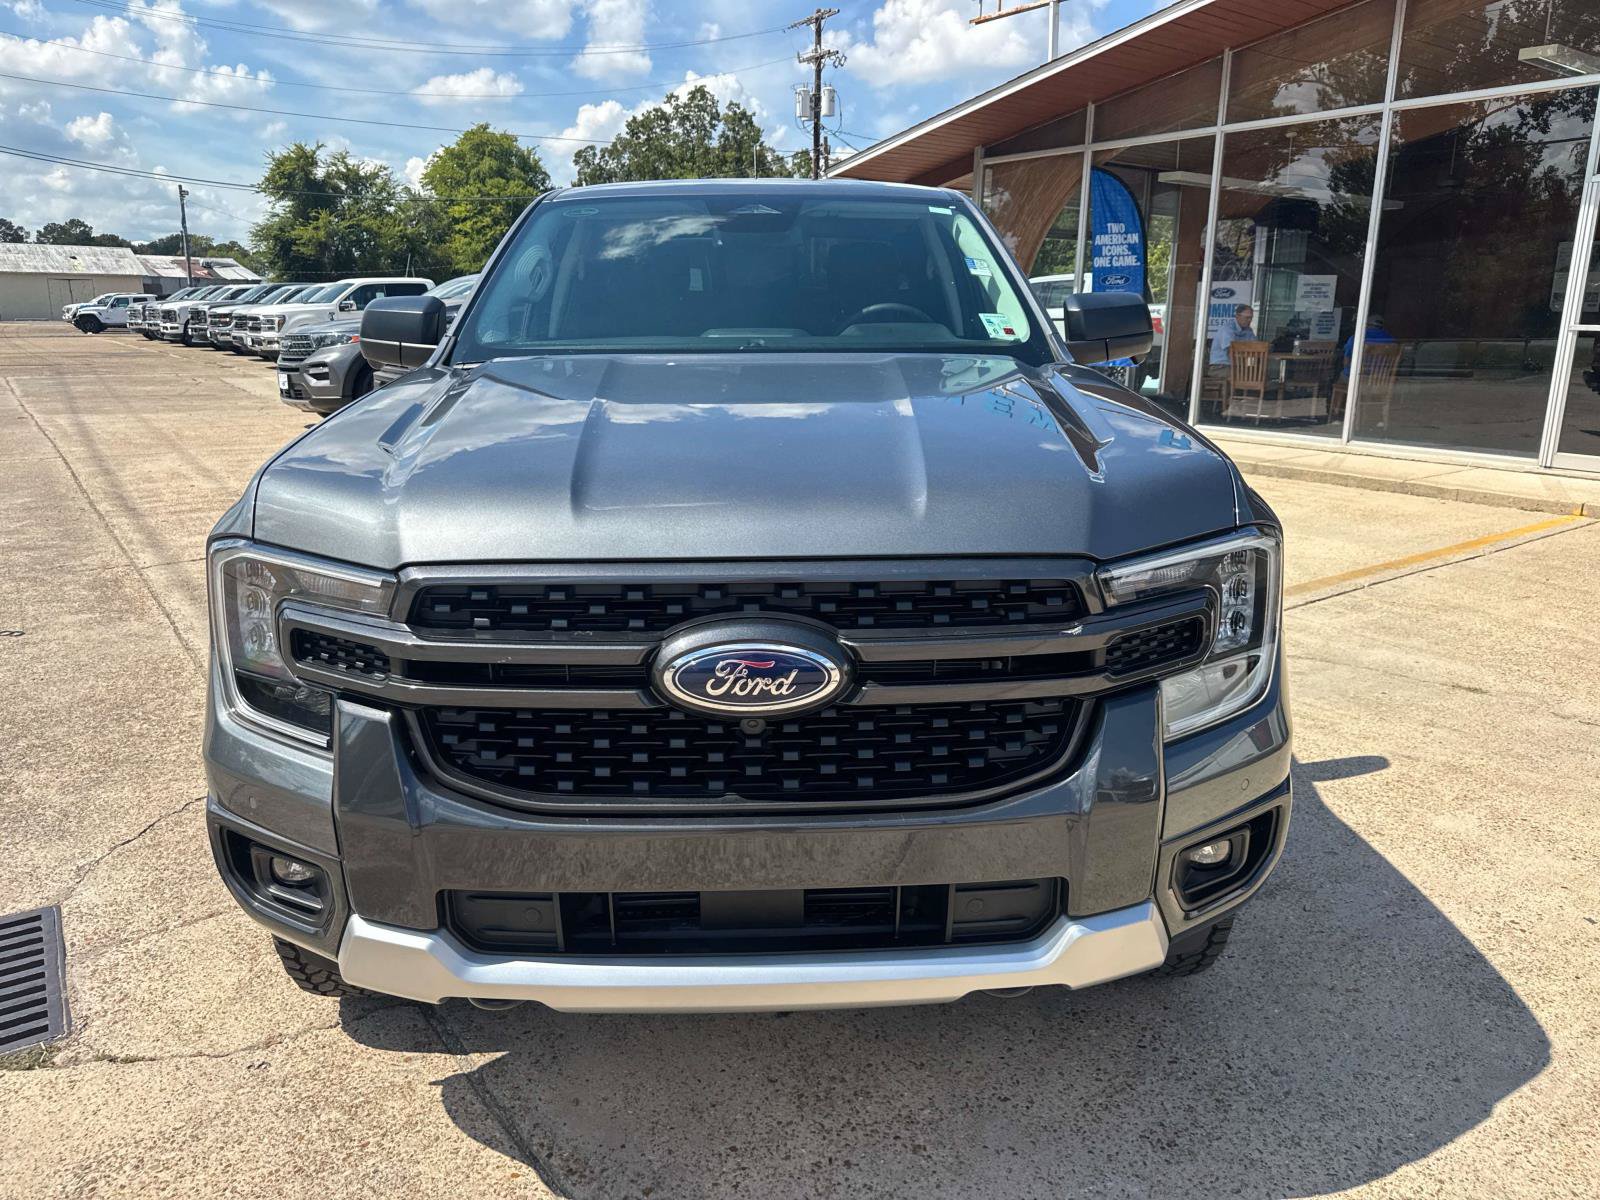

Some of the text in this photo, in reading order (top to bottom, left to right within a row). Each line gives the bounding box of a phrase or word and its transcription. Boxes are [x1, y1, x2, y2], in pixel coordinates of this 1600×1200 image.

[1107, 223, 1126, 234] TWO
[1094, 233, 1139, 245] AMERICAN
[1101, 245, 1132, 256] ICONS.
[1093, 255, 1141, 268] ONE GAME.
[1105, 275, 1126, 285] Ford
[1213, 288, 1232, 298] Ford
[705, 659, 799, 696] Ford
